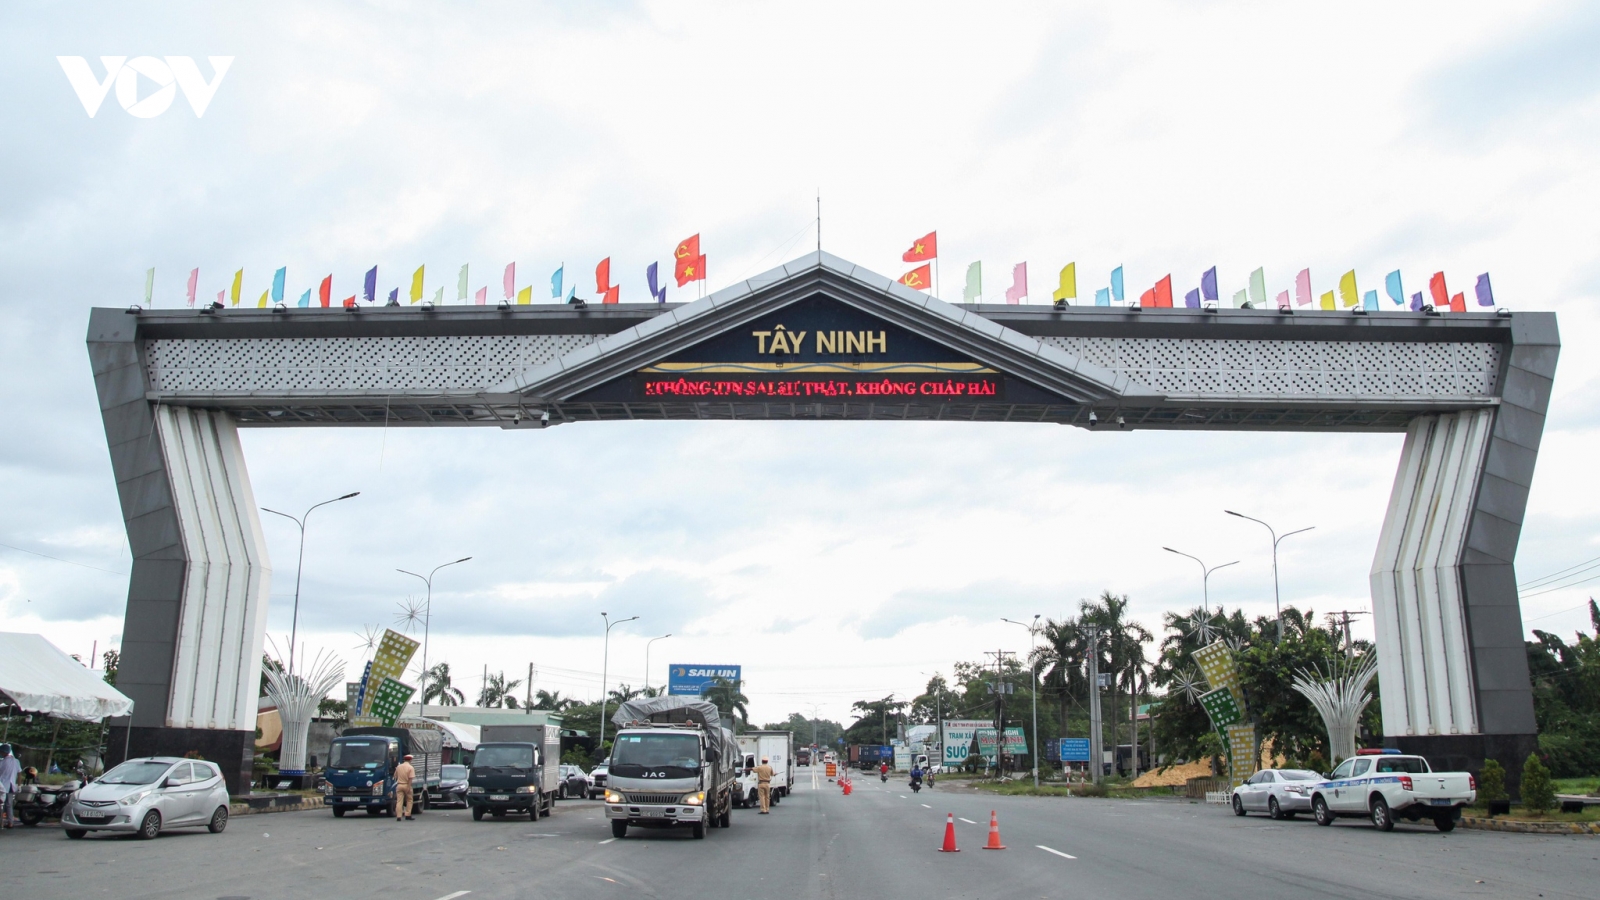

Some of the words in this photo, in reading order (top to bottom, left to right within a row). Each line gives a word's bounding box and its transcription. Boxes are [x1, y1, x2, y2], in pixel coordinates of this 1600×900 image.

[752, 324, 807, 354] TÂY
[816, 331, 887, 354] NINH
[855, 379, 916, 395] KHÔNG
[688, 668, 737, 677] SAILUN
